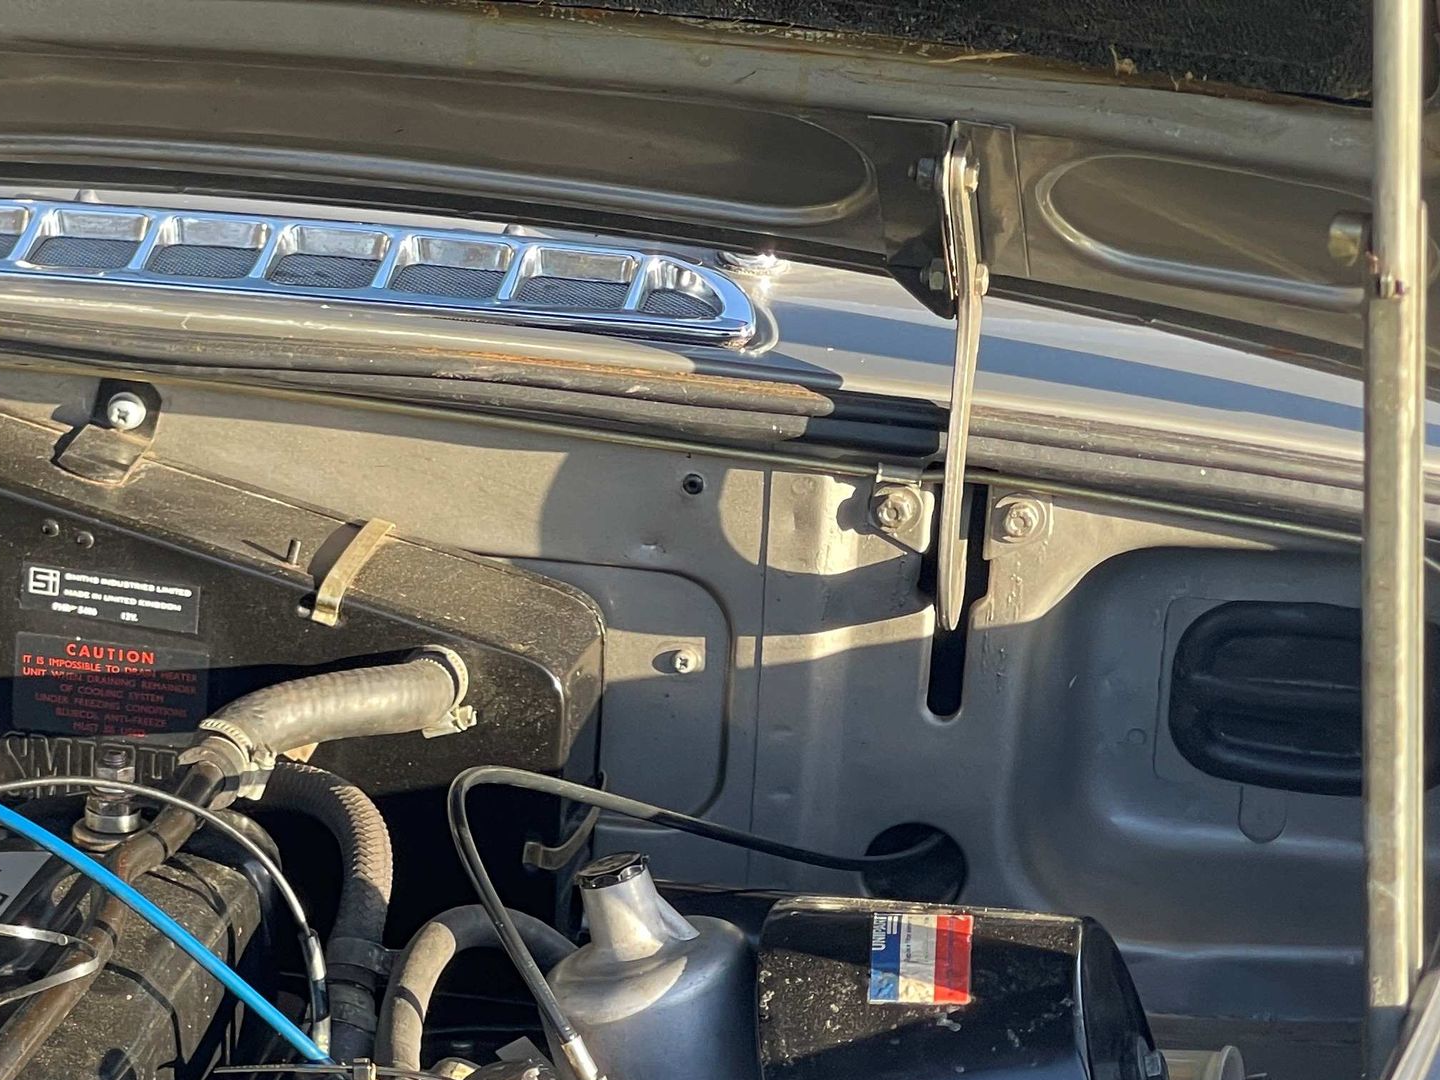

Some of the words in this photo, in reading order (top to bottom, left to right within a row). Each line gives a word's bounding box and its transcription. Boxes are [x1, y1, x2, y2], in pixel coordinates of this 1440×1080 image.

[63, 589, 90, 599] MADE
[91, 592, 102, 601] IN
[103, 594, 137, 605] UNITED
[156, 585, 192, 598] LIMITED
[66, 643, 155, 664] CAUTION
[23, 655, 32, 663] IT
[36, 656, 44, 665] IS
[49, 658, 101, 672] IMPOSSIBLE
[105, 664, 120, 674] TO
[23, 667, 47, 676] UNIT
[51, 670, 82, 682] WHEN
[87, 675, 136, 687] DRAINING
